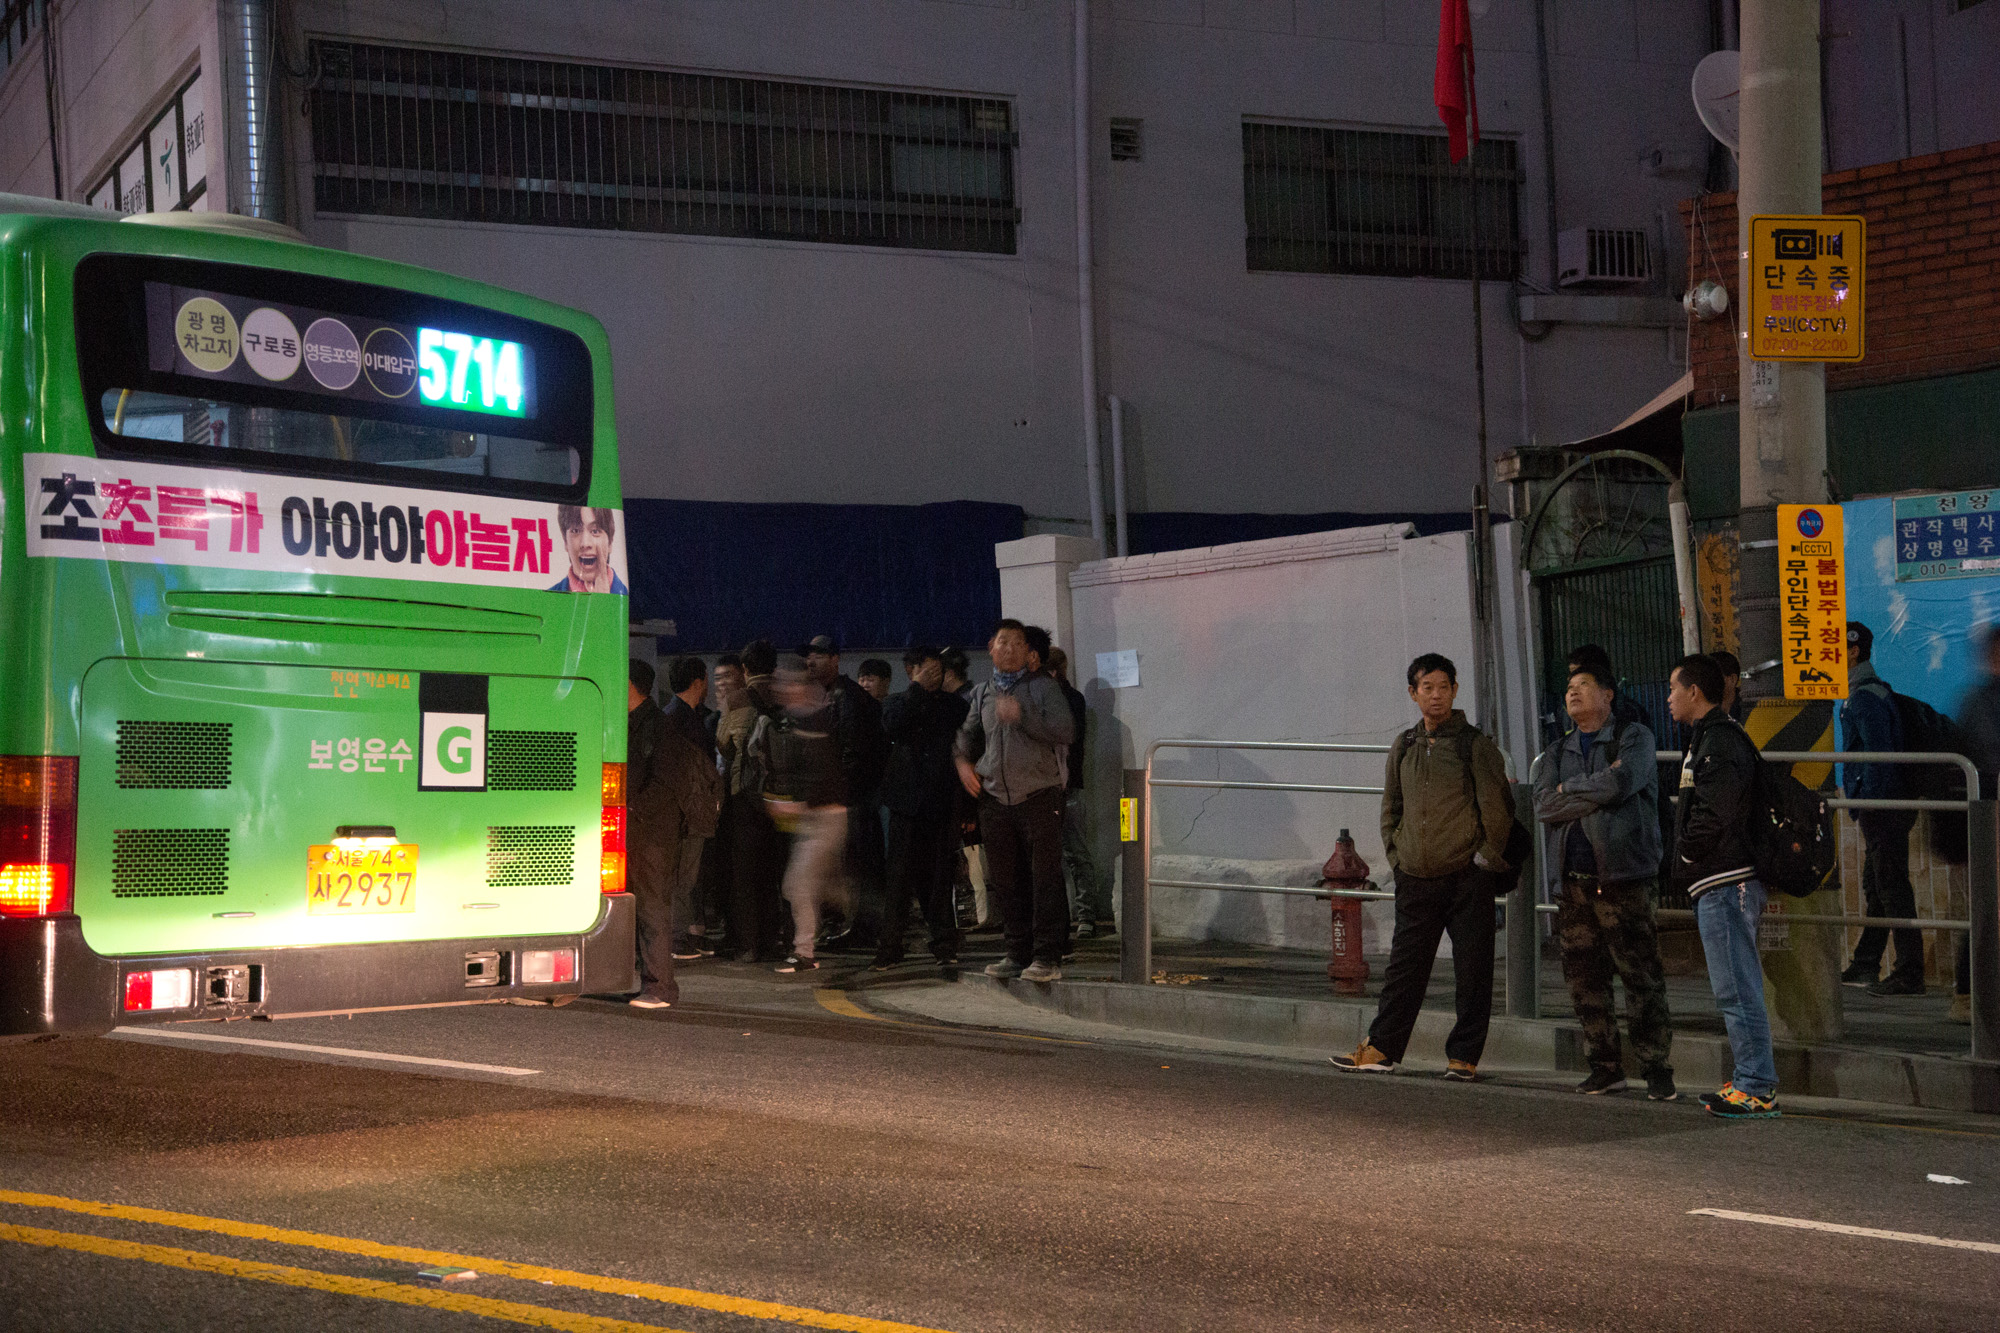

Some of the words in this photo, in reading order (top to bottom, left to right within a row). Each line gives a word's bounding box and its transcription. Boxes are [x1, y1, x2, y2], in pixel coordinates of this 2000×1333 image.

[1764, 264, 1850, 290] 단속중
[1770, 294, 1843, 312] 불법주정차
[187, 311, 225, 334] 광명
[1763, 315, 1847, 334] 무인(CCTV)
[184, 333, 233, 358] 차고지
[245, 332, 297, 359] 구로동
[305, 342, 360, 368] 영등포역
[364, 352, 417, 377] 이대입구
[419, 328, 522, 411] 5714
[41, 473, 264, 553] 초초특가
[281, 496, 553, 575] 야야야야놀자
[1803, 544, 1829, 554] CCTV
[1785, 559, 1812, 665] 무인단속구간
[330, 671, 410, 698] 천연가스버스
[1795, 686, 1840, 697] 견인지역
[308, 736, 413, 773] 보영운수
[436, 726, 472, 775] G
[336, 850, 364, 867] 서울
[371, 850, 393, 866] 74
